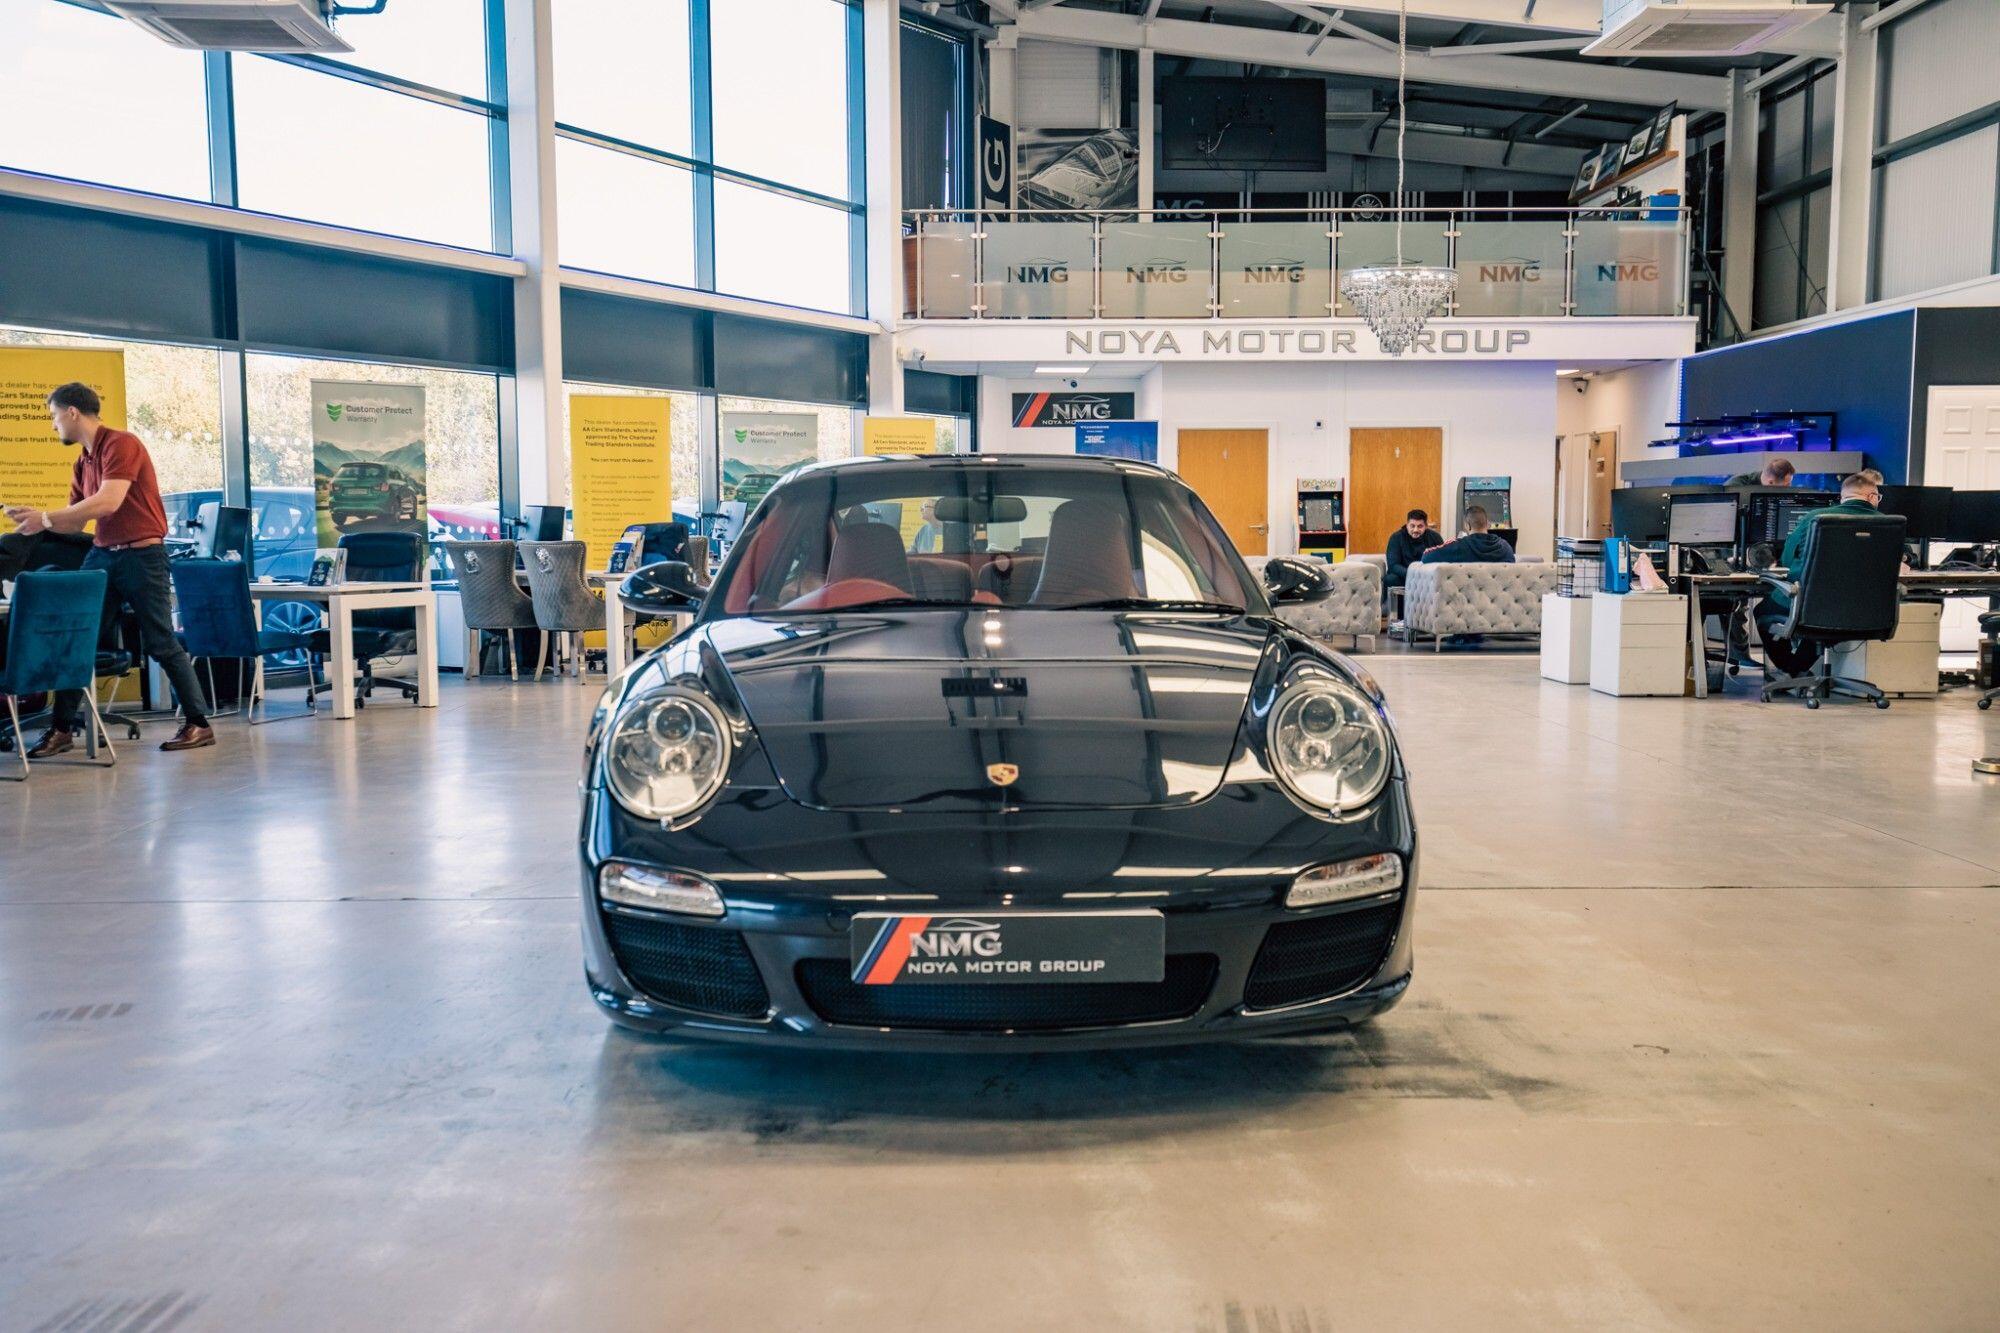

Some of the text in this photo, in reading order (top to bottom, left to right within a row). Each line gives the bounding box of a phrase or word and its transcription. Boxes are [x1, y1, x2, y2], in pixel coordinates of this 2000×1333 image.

[1008, 266, 1069, 283] NMG
[1126, 266, 1188, 283] NMG
[1244, 266, 1306, 283] NMG
[1479, 265, 1541, 282] NMG
[1598, 264, 1659, 281] NMG
[1066, 330, 1181, 353] NOYA
[1203, 330, 1357, 353] MOTOR
[346, 405, 383, 414] Customer
[1052, 403, 1111, 420] NMG
[908, 931, 1002, 957] NMG
[907, 959, 1106, 974] NOYA MOTOR GROUP
